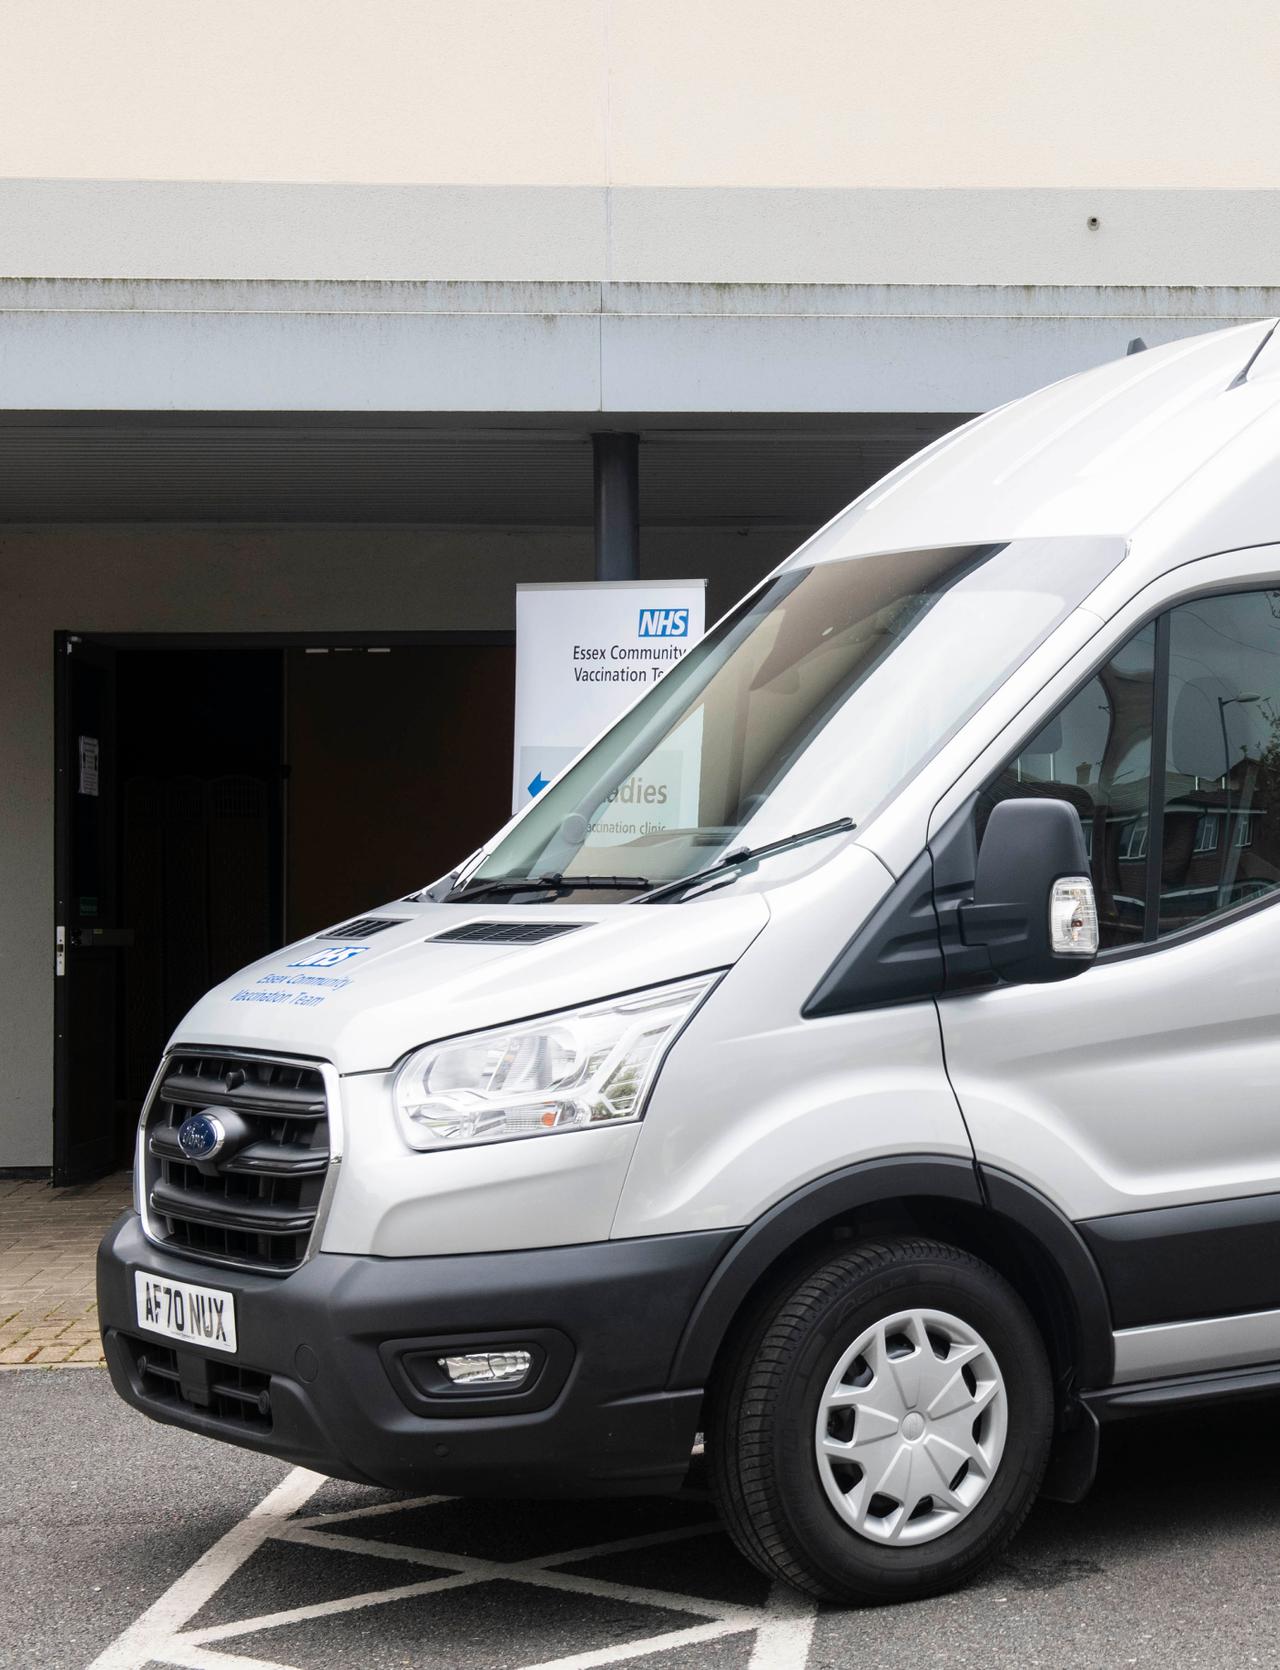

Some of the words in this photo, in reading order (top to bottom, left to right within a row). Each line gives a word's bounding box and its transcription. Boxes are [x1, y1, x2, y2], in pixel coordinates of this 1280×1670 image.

[639, 610, 689, 636] NHS
[572, 645, 607, 661] Essex
[573, 666, 648, 682] Vaccination
[585, 821, 636, 834] accination
[288, 946, 371, 968] NHS
[256, 973, 290, 985] Essex
[287, 973, 354, 992] Community
[230, 989, 293, 1004] Vaccination
[293, 991, 326, 1008] Team
[145, 1280, 185, 1332] AF70
[188, 1292, 228, 1342] NUX
